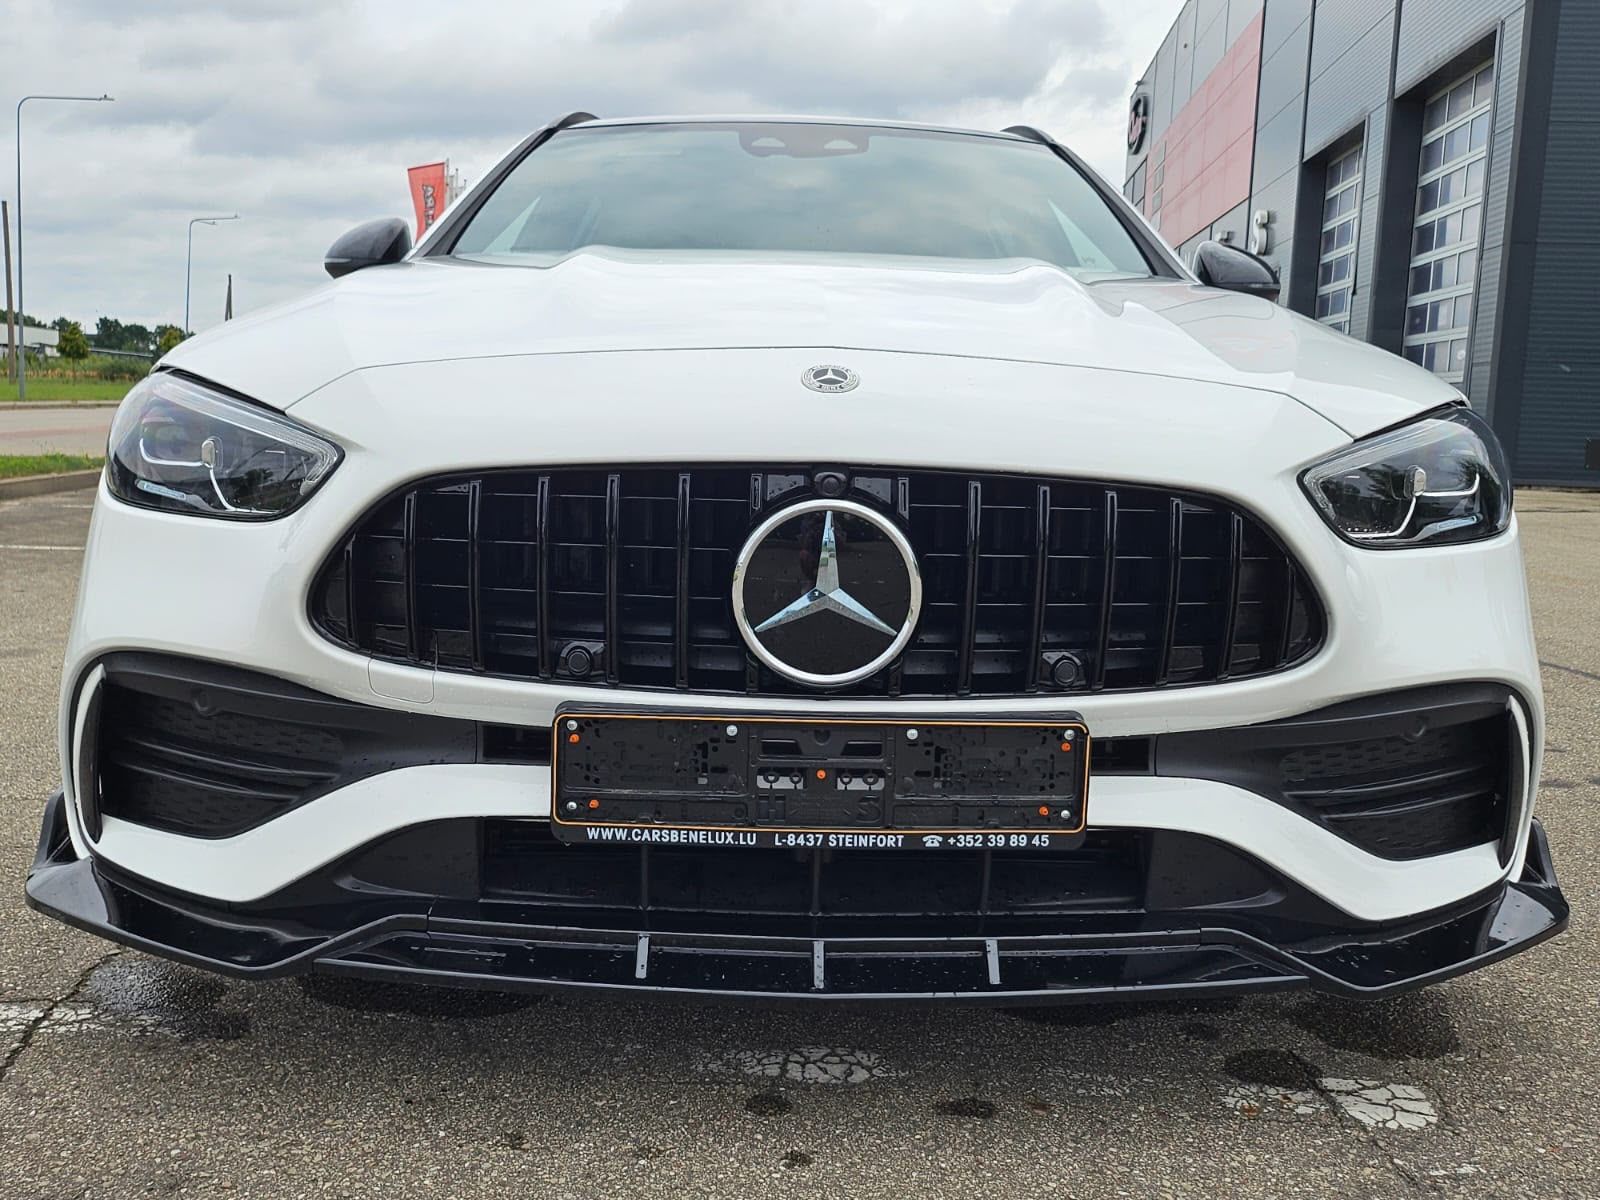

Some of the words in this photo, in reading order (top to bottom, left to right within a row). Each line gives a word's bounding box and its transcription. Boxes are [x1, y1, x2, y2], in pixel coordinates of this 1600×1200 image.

[586, 827, 757, 846] WWW.CARSBENELUX.LU
[774, 833, 824, 847] L-8437
[828, 834, 905, 848] STEINFORT
[947, 834, 983, 848] +352
[987, 834, 1006, 847] 39
[1009, 834, 1028, 847] 89
[1031, 834, 1050, 847] 45
